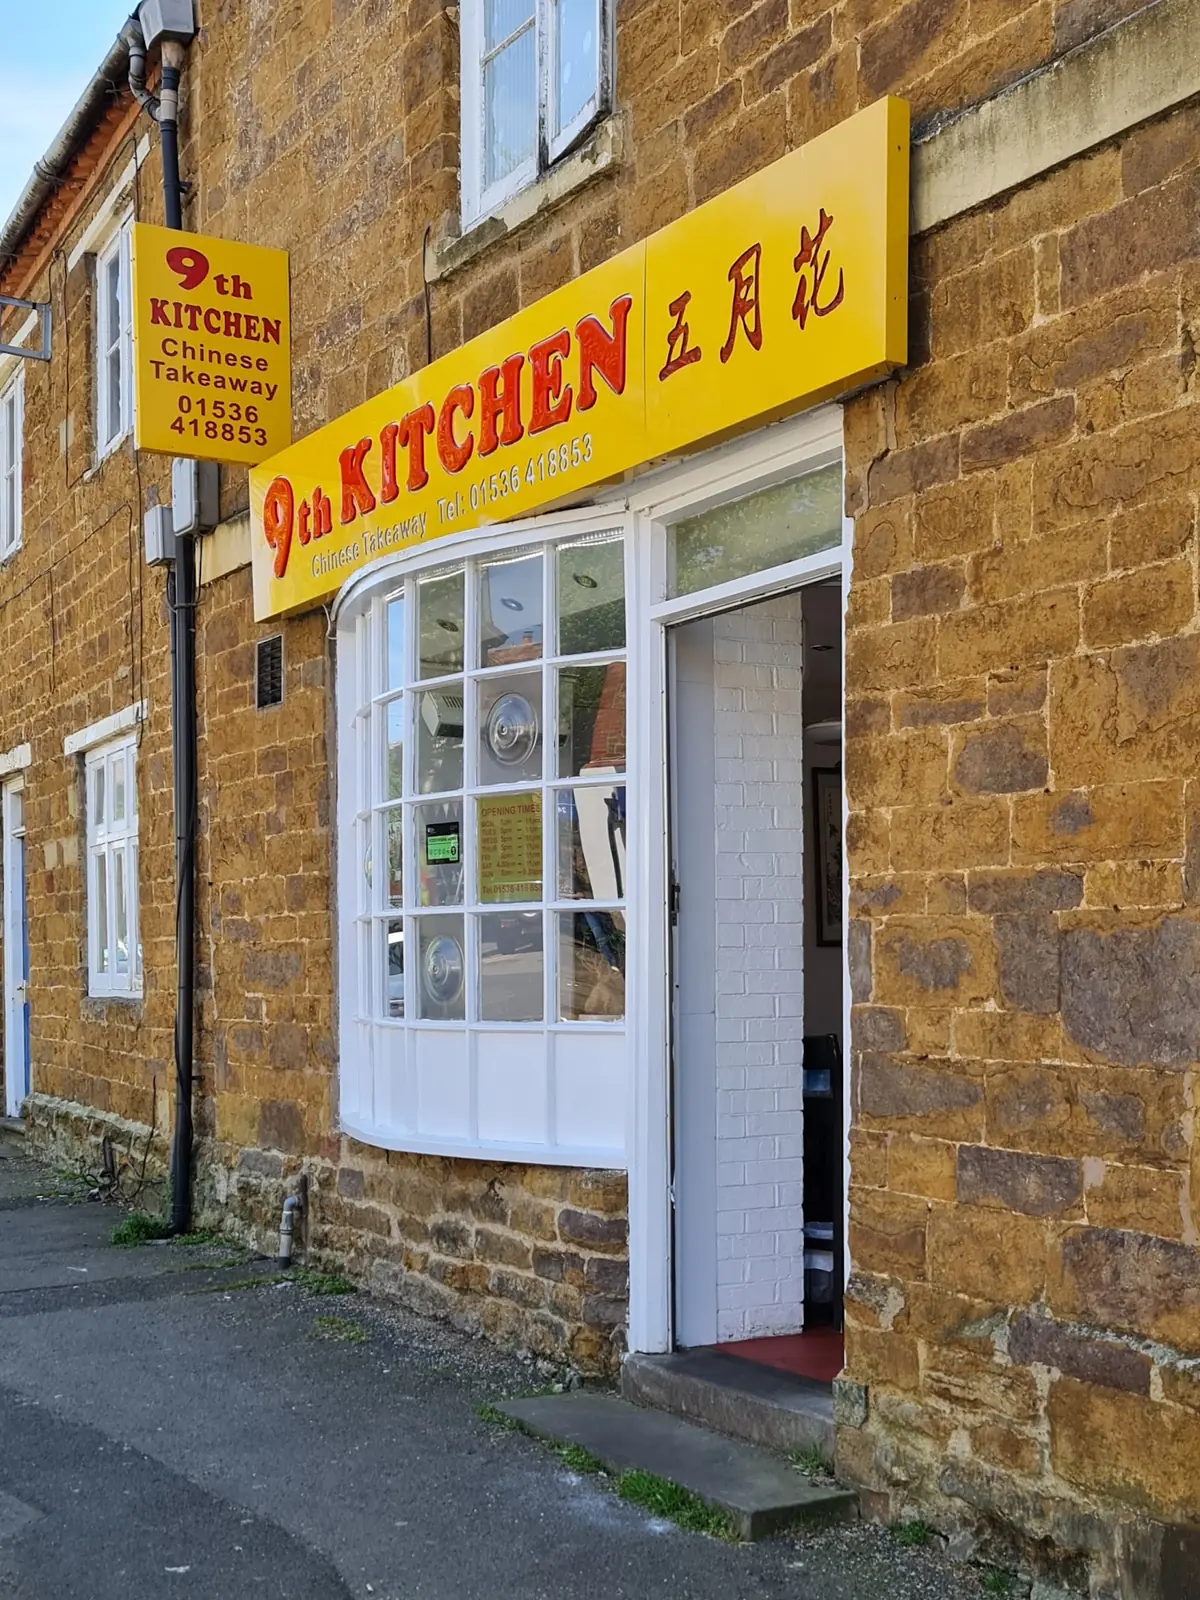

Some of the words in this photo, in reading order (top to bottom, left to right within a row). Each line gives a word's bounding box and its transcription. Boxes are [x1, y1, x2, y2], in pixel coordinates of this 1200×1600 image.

[166, 246, 253, 300] 9th
[659, 208, 844, 381] 五月花
[149, 298, 282, 345] KITCHEN
[161, 338, 269, 371] Chinese
[149, 359, 279, 401] Takeaway
[170, 416, 268, 446] 418853
[178, 395, 259, 424] 01536
[263, 474, 333, 579] 9th
[338, 293, 633, 525] KITCHEN
[310, 542, 360, 578] Chinese
[362, 510, 428, 557] Takeaway
[437, 494, 466, 523] Tel:
[469, 465, 521, 511] 01536
[524, 432, 594, 485] 418853
[481, 806, 516, 817] OPENING
